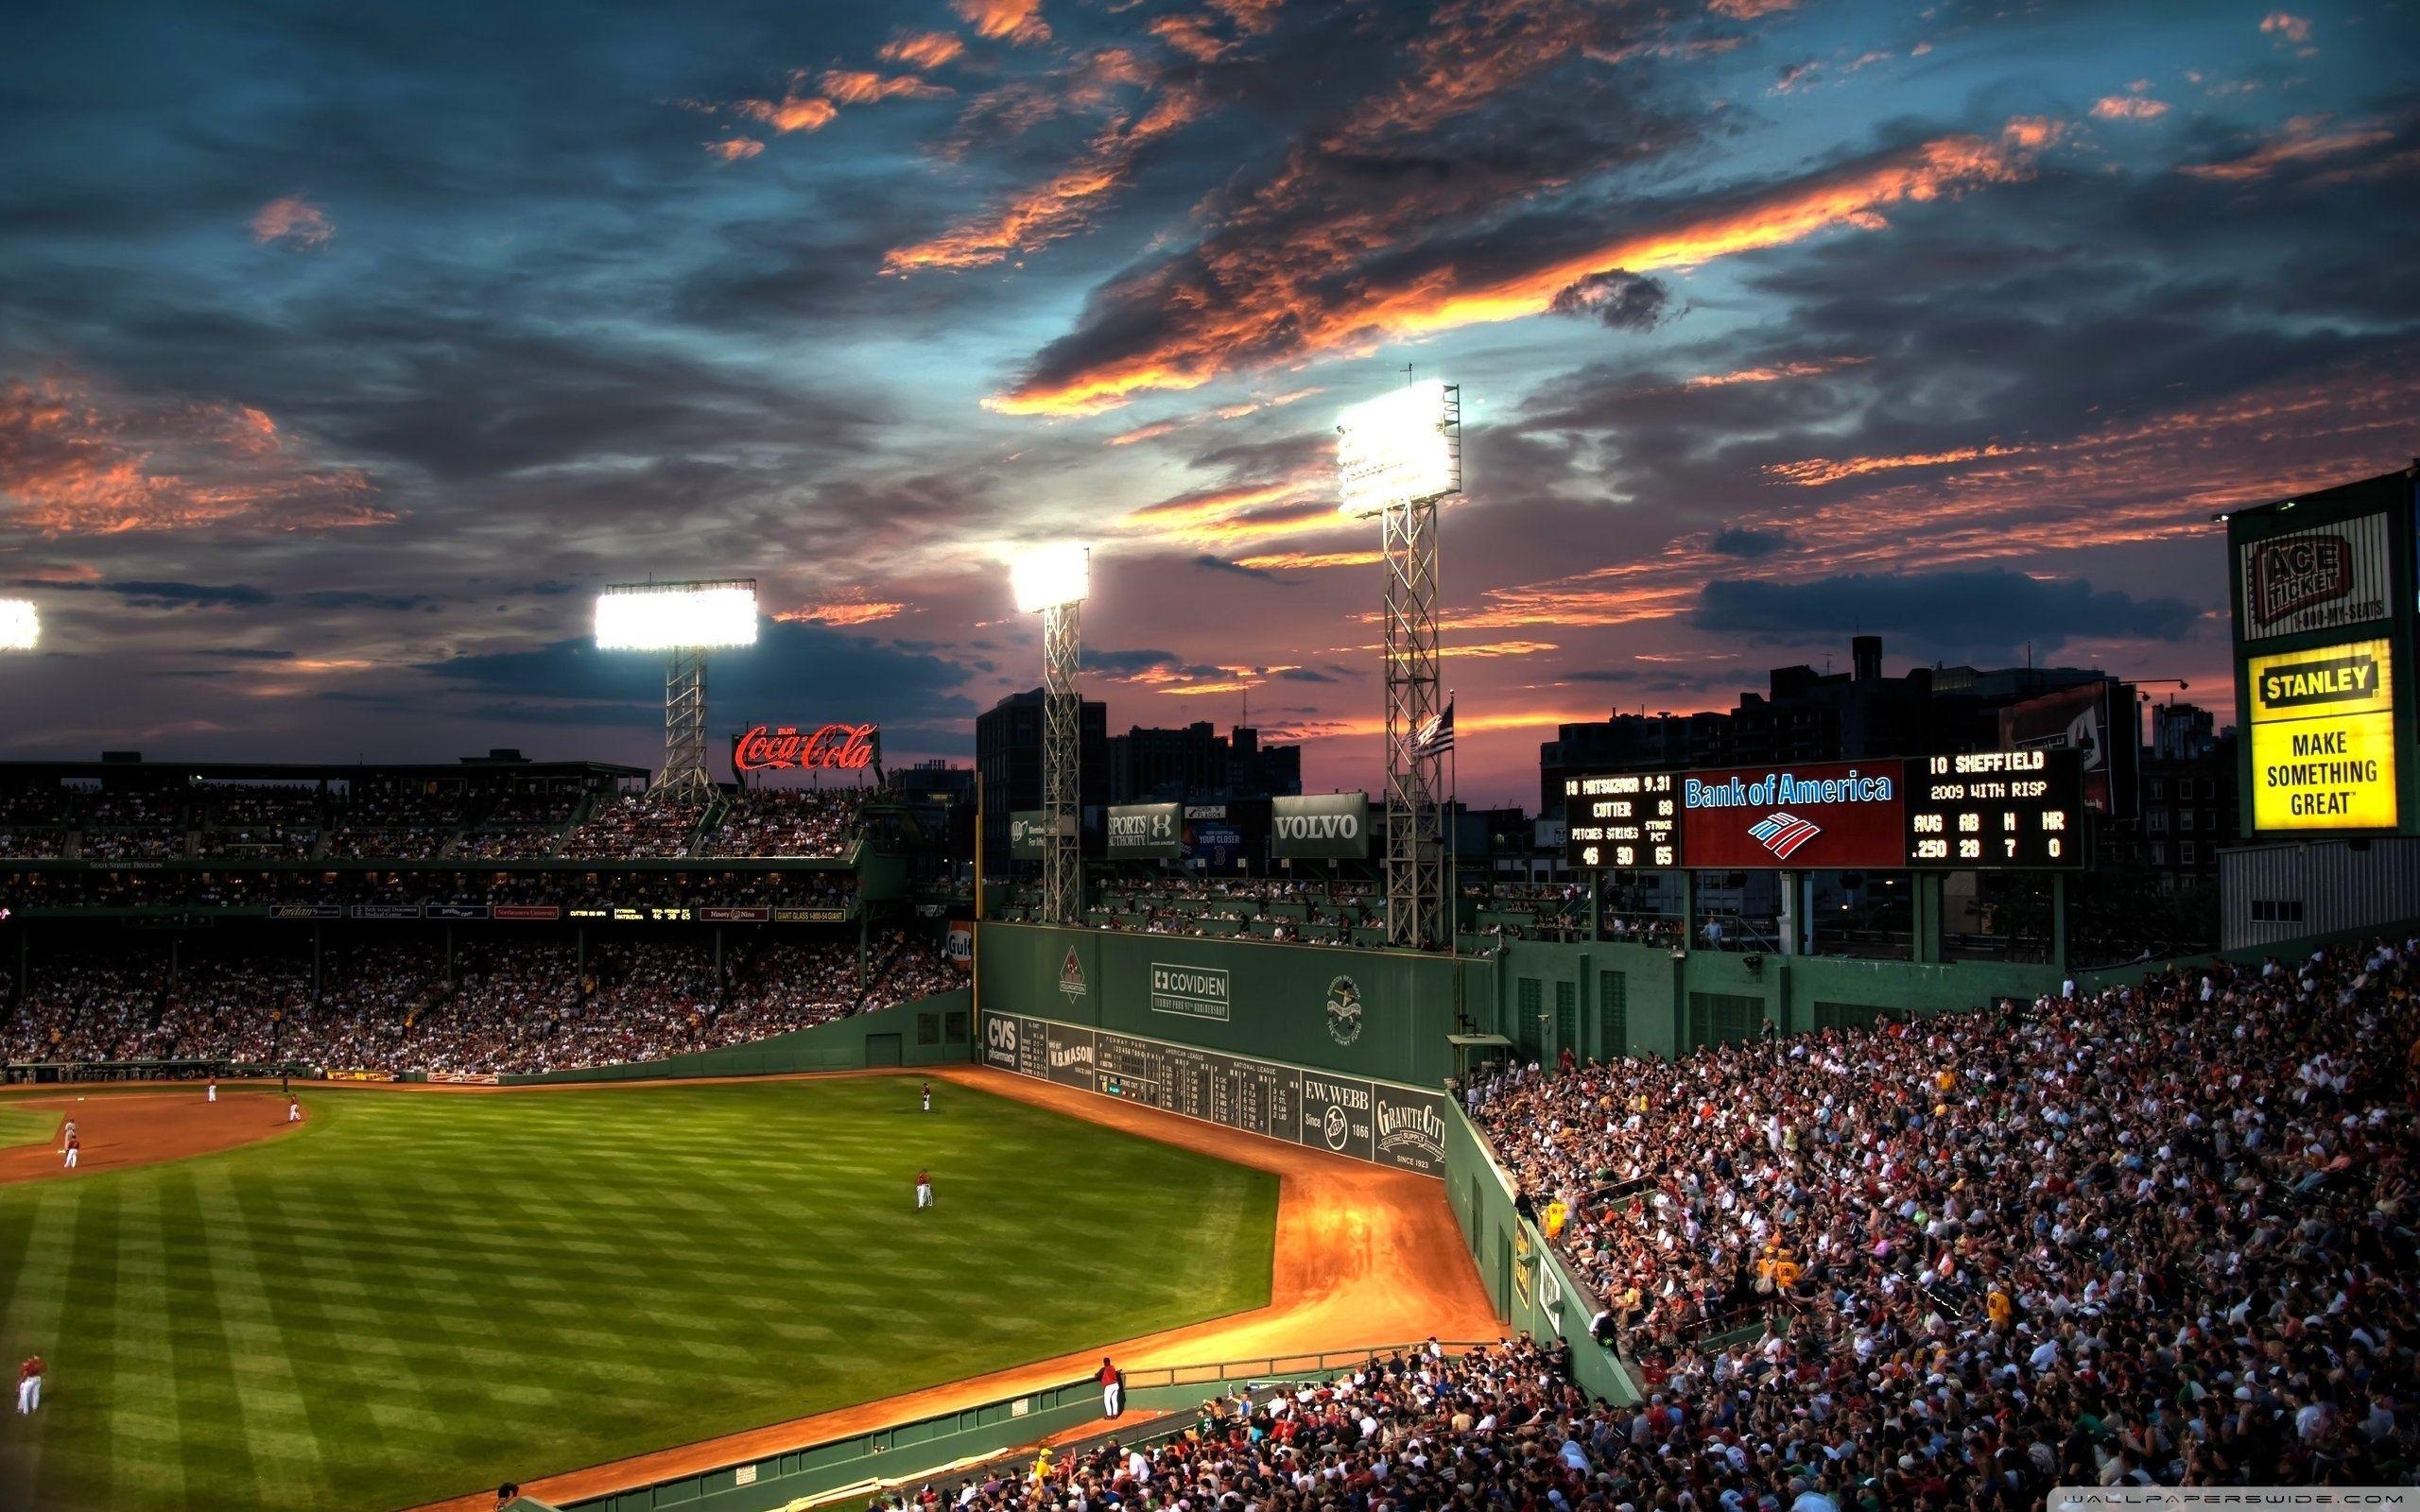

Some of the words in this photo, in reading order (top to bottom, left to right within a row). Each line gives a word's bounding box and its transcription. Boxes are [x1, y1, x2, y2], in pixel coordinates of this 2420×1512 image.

[2268, 541, 2341, 585] ACE
[2269, 573, 2338, 611] TICKET
[2292, 600, 2383, 629] 1-800-MY-SEATS
[2267, 665, 2369, 699] STANLEY
[735, 723, 879, 770] Coca-Cola
[2292, 731, 2347, 757] MAKE
[1930, 757, 1947, 774] 10
[1955, 751, 2044, 773] SHEFFIELD
[2267, 760, 2377, 787] SOMETHING
[1582, 778, 1639, 795] MATSUZAKA
[1644, 775, 1669, 792] 9.31
[1685, 777, 1746, 808] Bank
[1748, 774, 1776, 805] of
[1778, 770, 1893, 804] America
[1931, 785, 1964, 799] 2009
[1970, 782, 2005, 798] WITH
[2012, 782, 2047, 797] RISP
[1593, 802, 1632, 817] CUTTER
[2291, 792, 2350, 816] GREAT
[1107, 815, 1146, 834] SPORTS
[1274, 814, 1358, 840] VOLVO
[1645, 820, 1672, 831] STRIKE
[1913, 815, 1943, 833] AVG
[1959, 814, 1979, 832] AB
[2004, 812, 2015, 831] H
[2042, 811, 2065, 831] HR
[1028, 837, 1037, 847] For
[1107, 835, 1146, 848] AUTHORITY
[1199, 835, 1216, 844] YOUR
[1217, 835, 1241, 844] CLOSER
[1572, 828, 1603, 840] PITCHES
[1606, 827, 1639, 840] STRIKES
[1651, 832, 1667, 842] PCT
[1582, 847, 1599, 865] 46
[1616, 846, 1634, 865] 30
[1655, 846, 1672, 865] 65
[1912, 839, 1947, 858] .250
[1959, 839, 1980, 858] 28
[2004, 838, 2016, 857] 7
[2048, 837, 2061, 857] 0
[277, 907, 319, 918] Jordan's
[442, 908, 474, 918] boston.com
[1061, 983, 1085, 992] FOUNDATION
[1170, 972, 1225, 997] COVIDIEN
[1327, 975, 1342, 997] BOSTON
[1343, 974, 1353, 984] RED
[1154, 997, 1172, 1008] FENWAY
[1172, 999, 1184, 1010] PARK
[1194, 1002, 1225, 1016] ANNIVERSARY
[988, 1017, 1016, 1051] CVS
[1105, 1036, 1128, 1045] FENWAY
[1131, 1040, 1146, 1049] PARK
[1335, 1038, 1351, 1046] JIMMY
[1351, 1022, 1362, 1042] FUND
[988, 1047, 1016, 1067] pharmacy
[1165, 1048, 1186, 1057] AMERICAN
[1187, 1052, 1204, 1060] LEAGUE
[1234, 1061, 1255, 1072] NATIONAL
[1257, 1066, 1276, 1075] LEAGUE
[1305, 1080, 1328, 1103] F.W.
[1328, 1085, 1369, 1110] WEBB
[1305, 1112, 1322, 1128] Since
[1352, 1124, 1369, 1139] 1866
[1377, 1099, 1422, 1137] GRANITE
[1384, 1136, 1403, 1145] ELECTRIC
[1403, 1132, 1425, 1143] SUPPLY
[1396, 1155, 1414, 1166] SINCE
[1415, 1159, 1429, 1169] 1923
